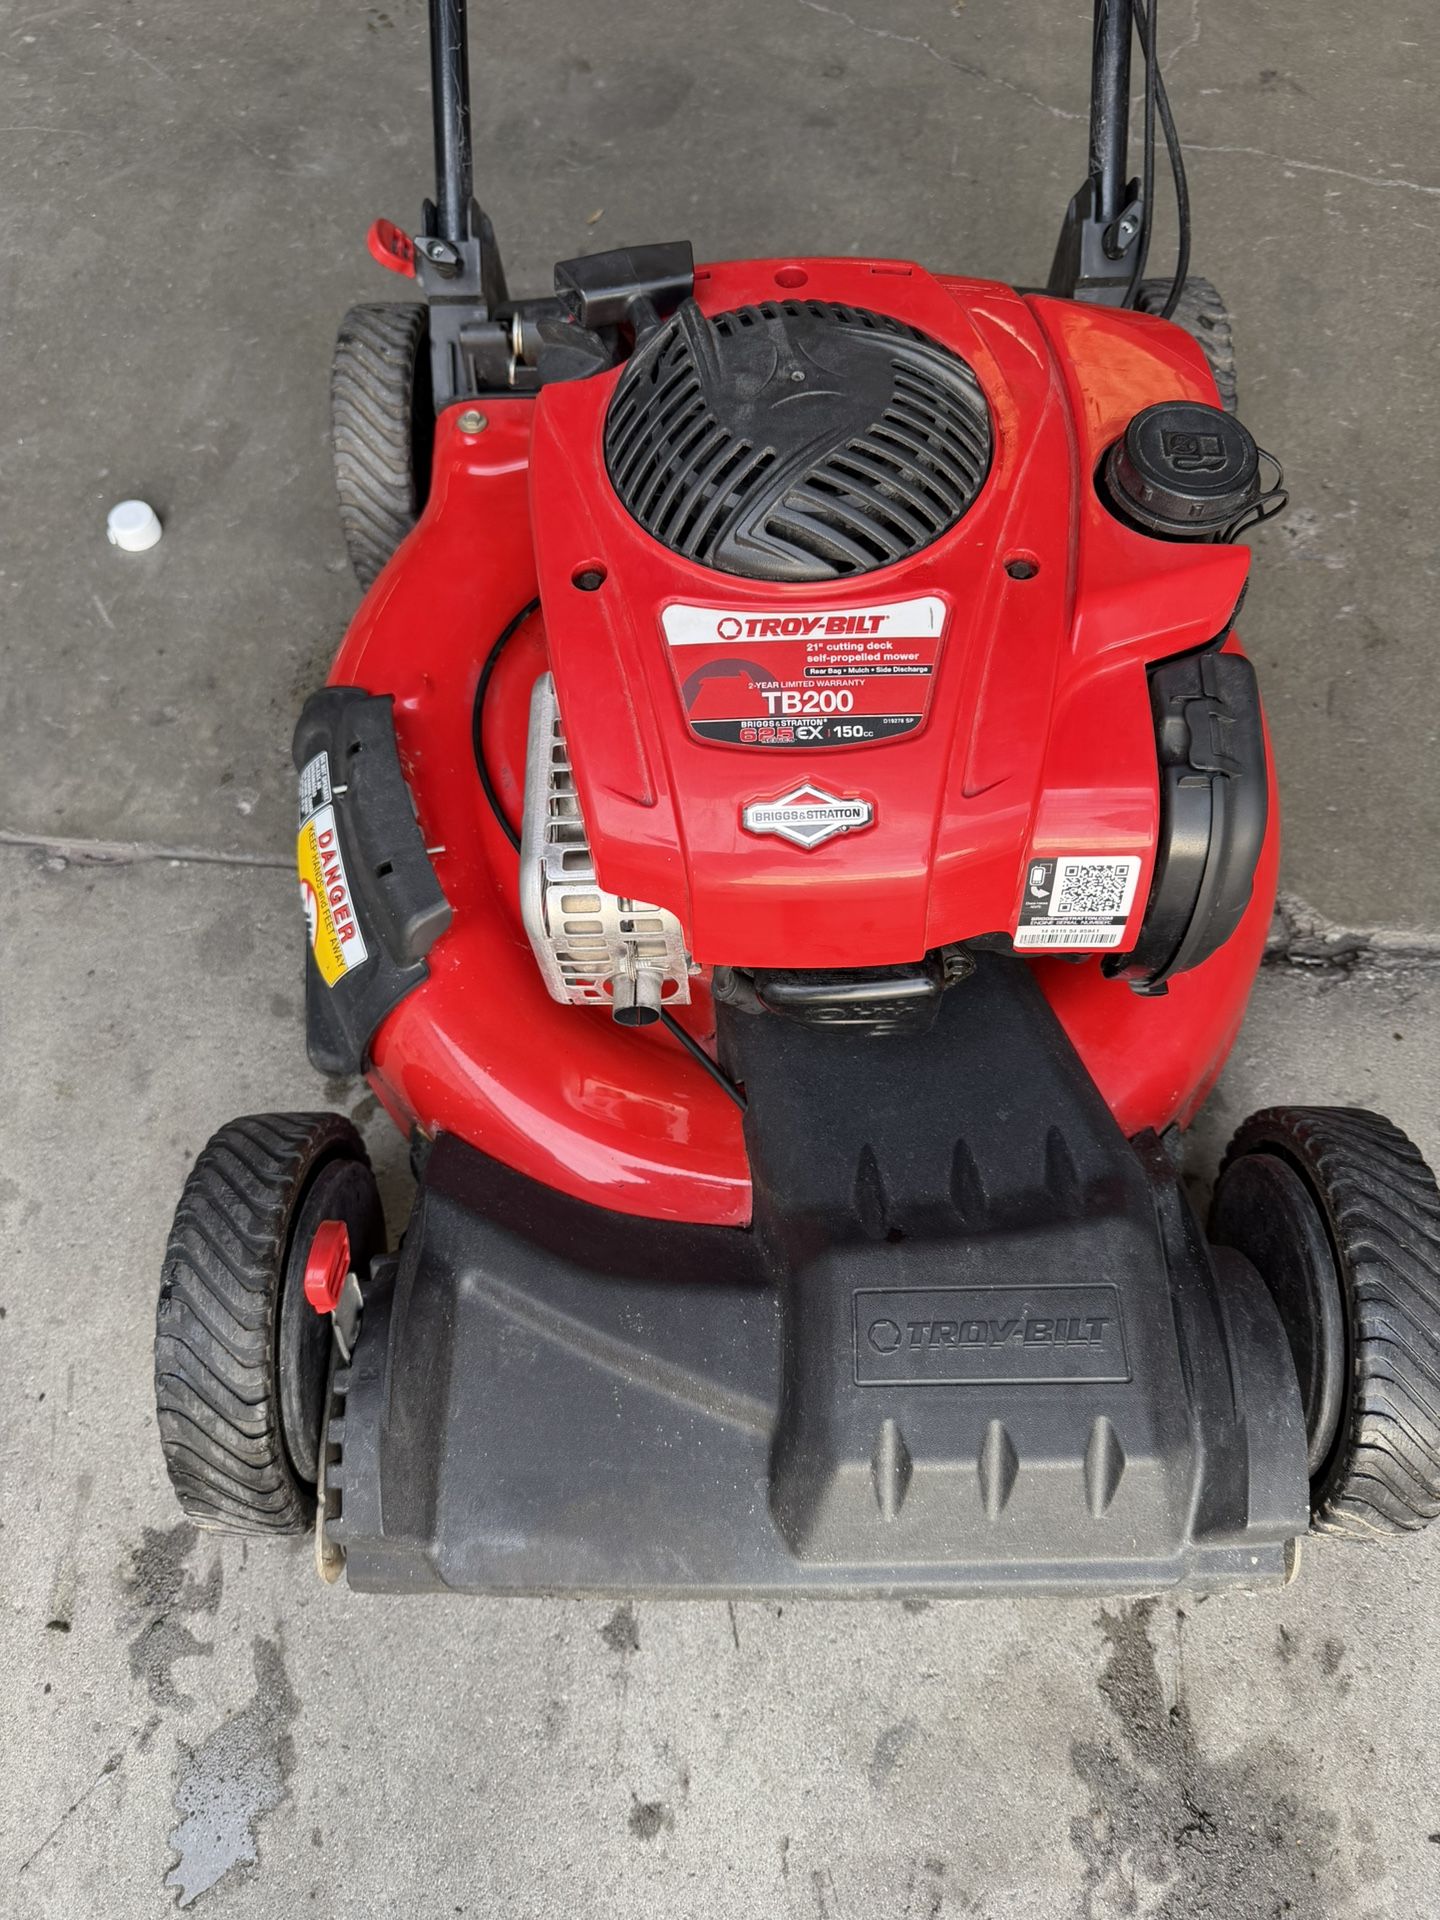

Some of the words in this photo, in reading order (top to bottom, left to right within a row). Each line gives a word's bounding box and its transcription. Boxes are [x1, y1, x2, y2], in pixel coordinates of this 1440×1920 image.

[745, 615, 885, 638] TROY-BILT
[806, 642, 823, 651] 21"
[826, 642, 864, 653] cutting
[867, 641, 893, 650] deck
[806, 653, 881, 664] self-propelled
[883, 652, 920, 661] mower
[828, 668, 842, 676] Bag
[893, 666, 928, 674] Discharge
[780, 680, 815, 688] LIMITED
[816, 679, 865, 687] WARRANTY
[761, 689, 854, 714] TB200
[740, 727, 794, 742] 625
[796, 726, 824, 740] EX
[307, 826, 319, 852] KEEP
[311, 852, 324, 890] HANDS
[317, 828, 356, 946] DANGER
[318, 891, 326, 909] and
[322, 906, 336, 935] FEET
[330, 937, 346, 969] AWAY
[906, 1317, 1109, 1351] TROY-BILT
